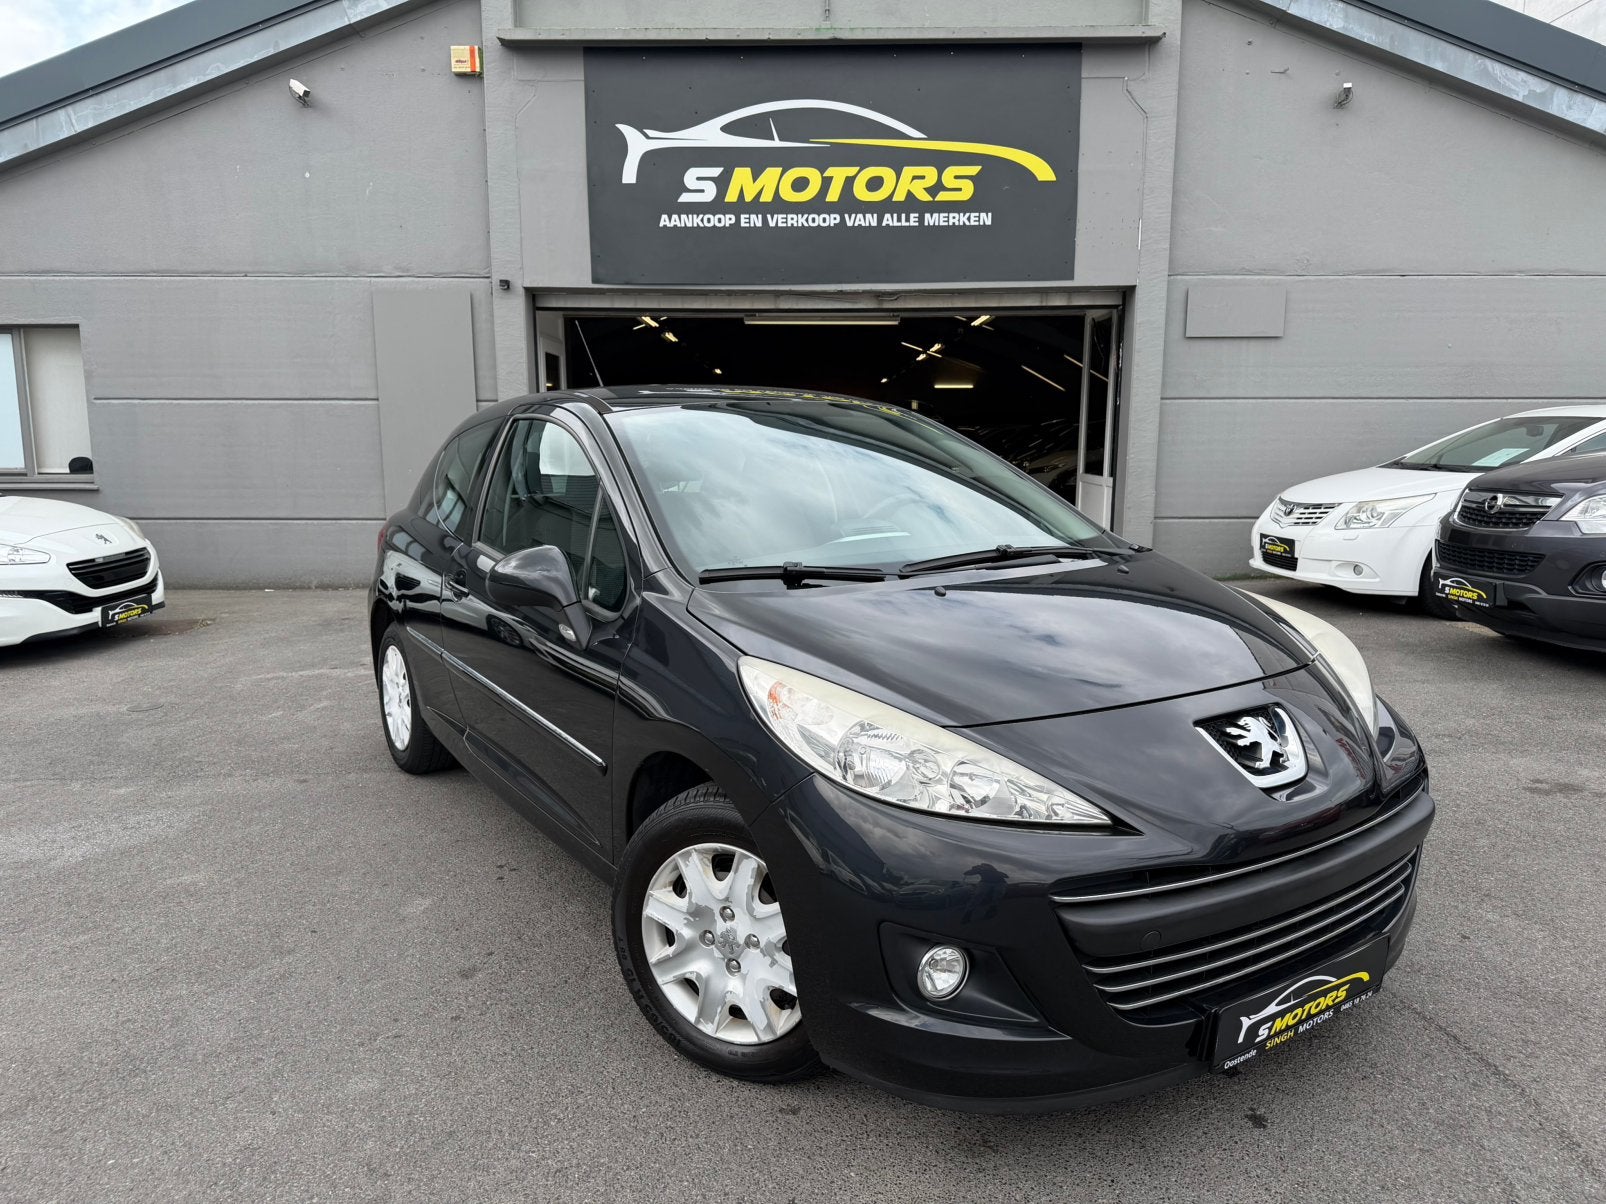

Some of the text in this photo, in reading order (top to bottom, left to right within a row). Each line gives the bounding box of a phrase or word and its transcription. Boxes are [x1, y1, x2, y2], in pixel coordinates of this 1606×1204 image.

[678, 166, 982, 203] S MOTORS
[659, 212, 992, 228] AANKOOP EN VERKOOP VAN ALLE MERKEN
[1450, 587, 1478, 600] MOTORS
[1270, 983, 1351, 1036] MOTORS
[1224, 1008, 1334, 1070] Oostende SINGH MOTORS
